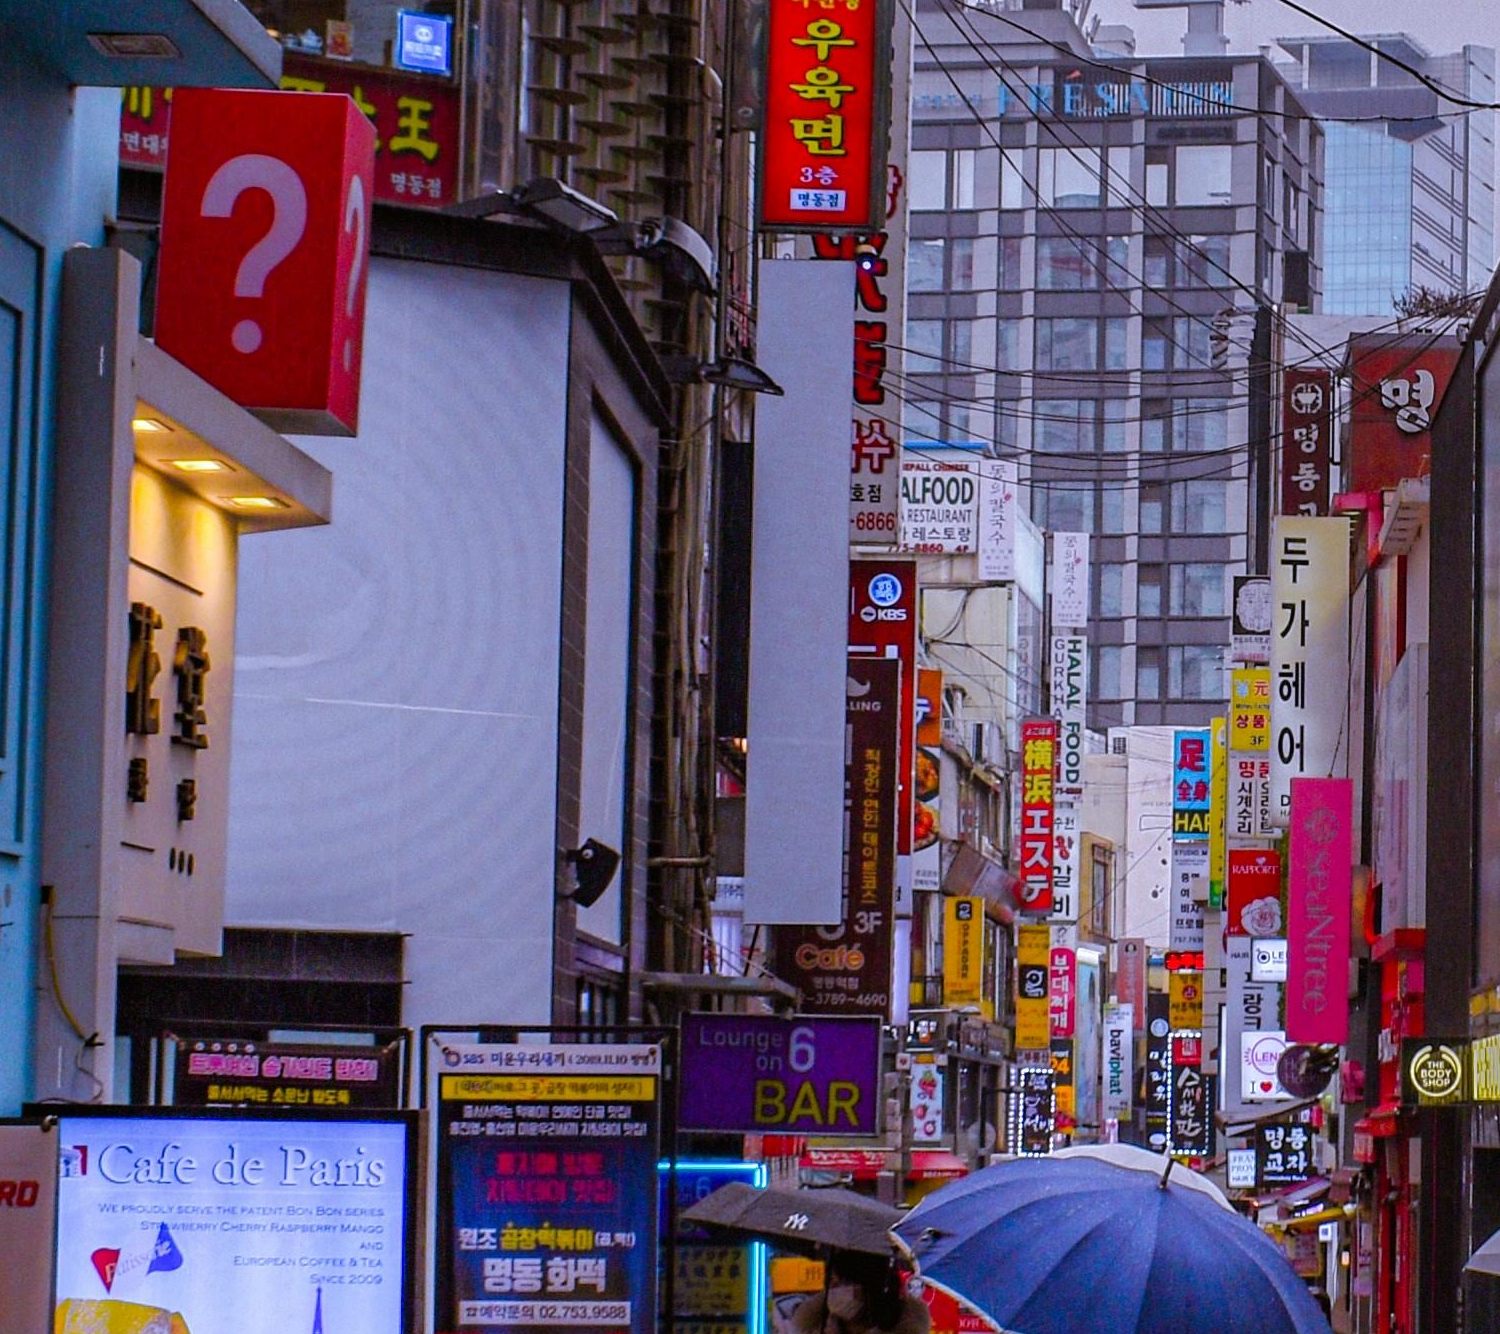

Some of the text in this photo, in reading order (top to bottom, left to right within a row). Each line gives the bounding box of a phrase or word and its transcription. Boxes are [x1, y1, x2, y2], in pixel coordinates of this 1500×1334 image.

[789, 18, 856, 157] 우육면
[390, 172, 442, 198] 명동점
[800, 166, 839, 185] 3층
[797, 191, 840, 208] 명동점
[877, 608, 908, 621] KBS
[1277, 536, 1310, 773] 두가헤어
[1053, 638, 1066, 722] GURKHA
[1065, 638, 1082, 784] HALAL FOOD
[853, 911, 883, 934] 3F
[796, 943, 865, 970] Café
[699, 1024, 784, 1051] Lounge
[755, 1052, 784, 1071] on
[1108, 1028, 1125, 1096] baviphat
[1420, 1069, 1452, 1079] BODY
[1422, 1079, 1451, 1088] SHOP
[753, 1080, 861, 1127] BAR
[1263, 1126, 1309, 1150] 명동
[98, 1142, 386, 1188] Cafe de Paris
[1263, 1152, 1309, 1173] 교자
[458, 1227, 497, 1251] 원조
[348, 1274, 384, 1285] 2009
[483, 1257, 543, 1294] 명동
[546, 1257, 607, 1293] 화떡
